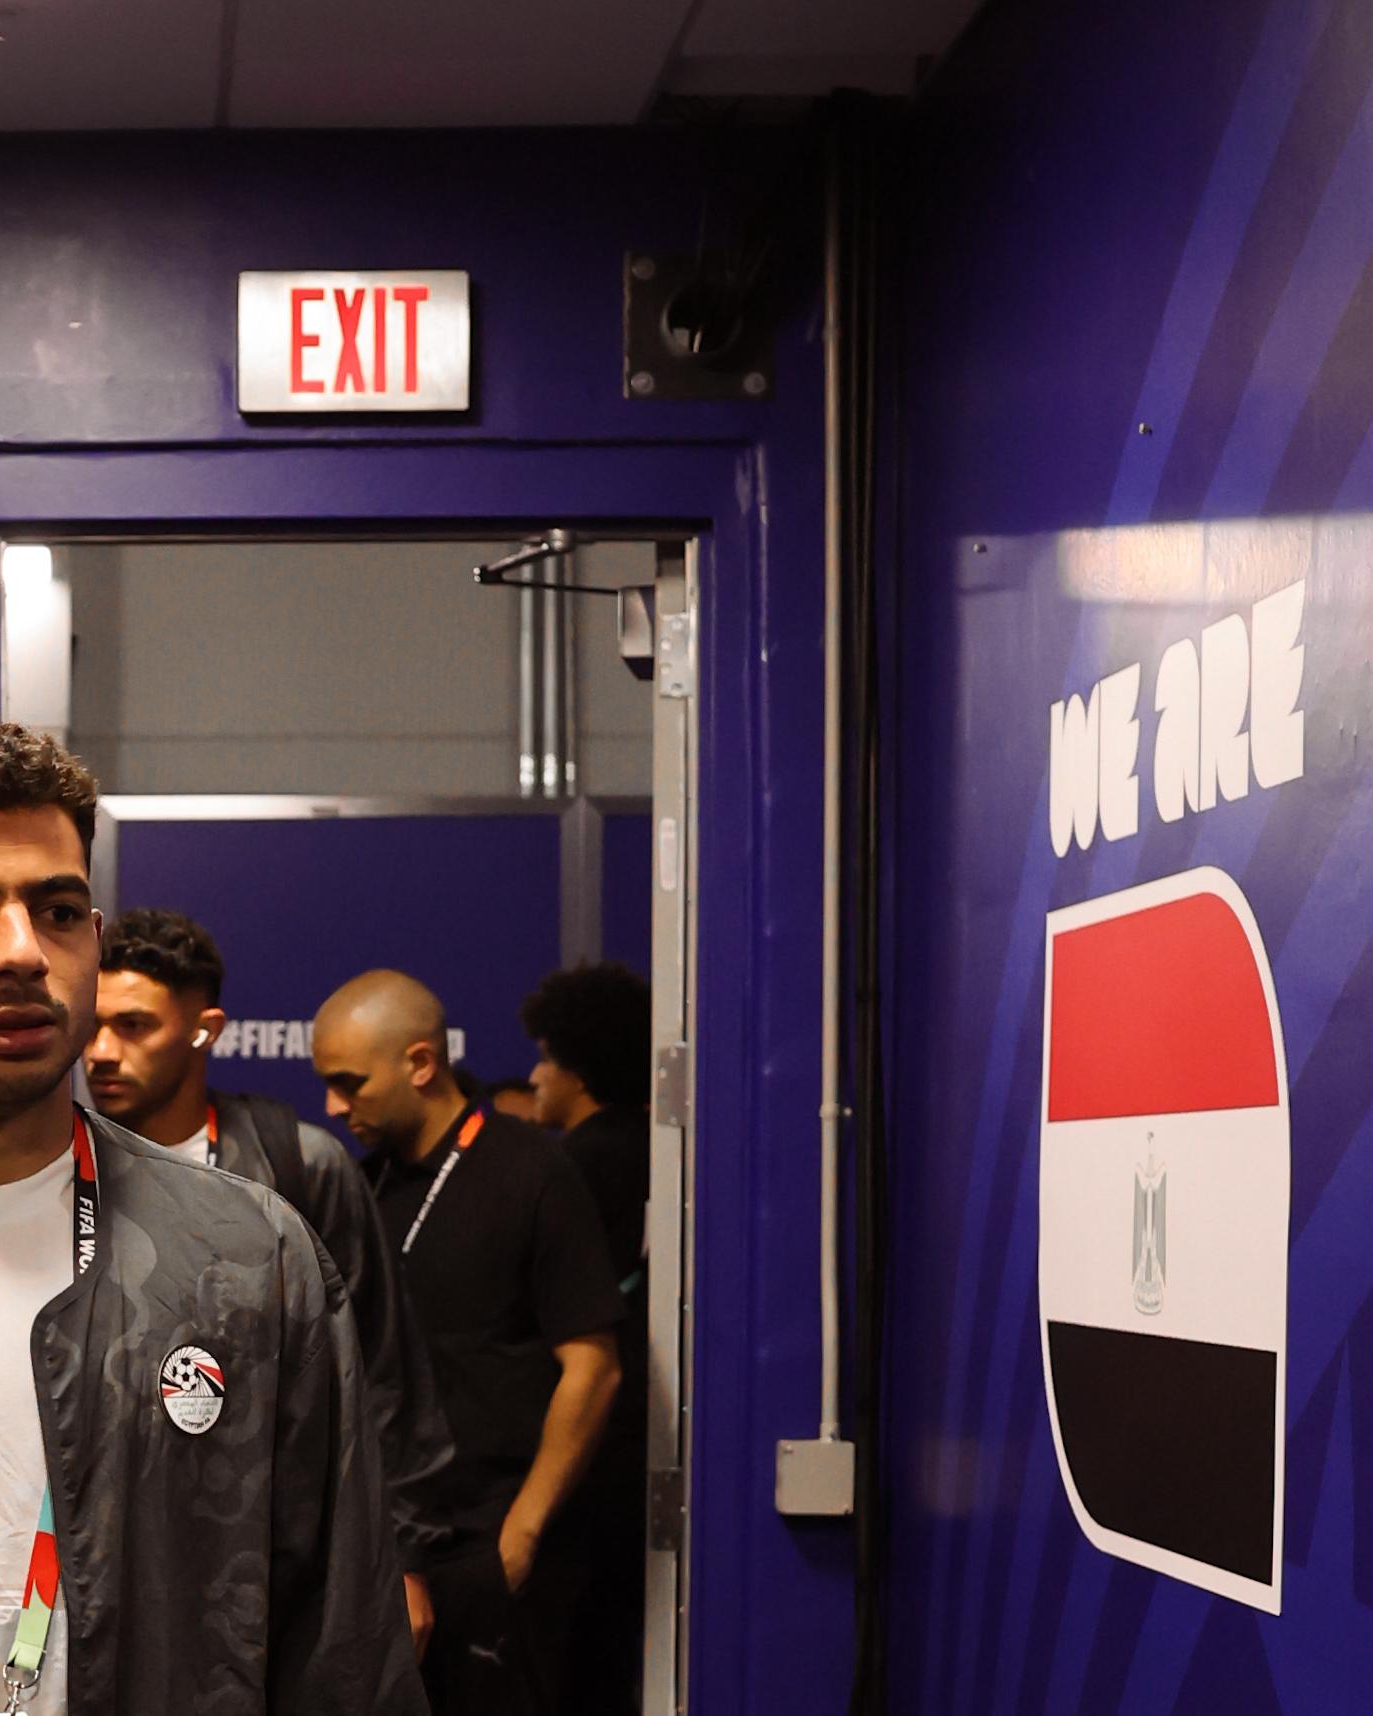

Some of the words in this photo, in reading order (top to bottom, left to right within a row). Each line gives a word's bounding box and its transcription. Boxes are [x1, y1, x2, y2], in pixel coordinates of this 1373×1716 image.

[290, 288, 429, 393] EXIT
[1049, 662, 1141, 858] WE
[1154, 579, 1306, 823] ARE
[79, 1195, 96, 1235] FIFA
